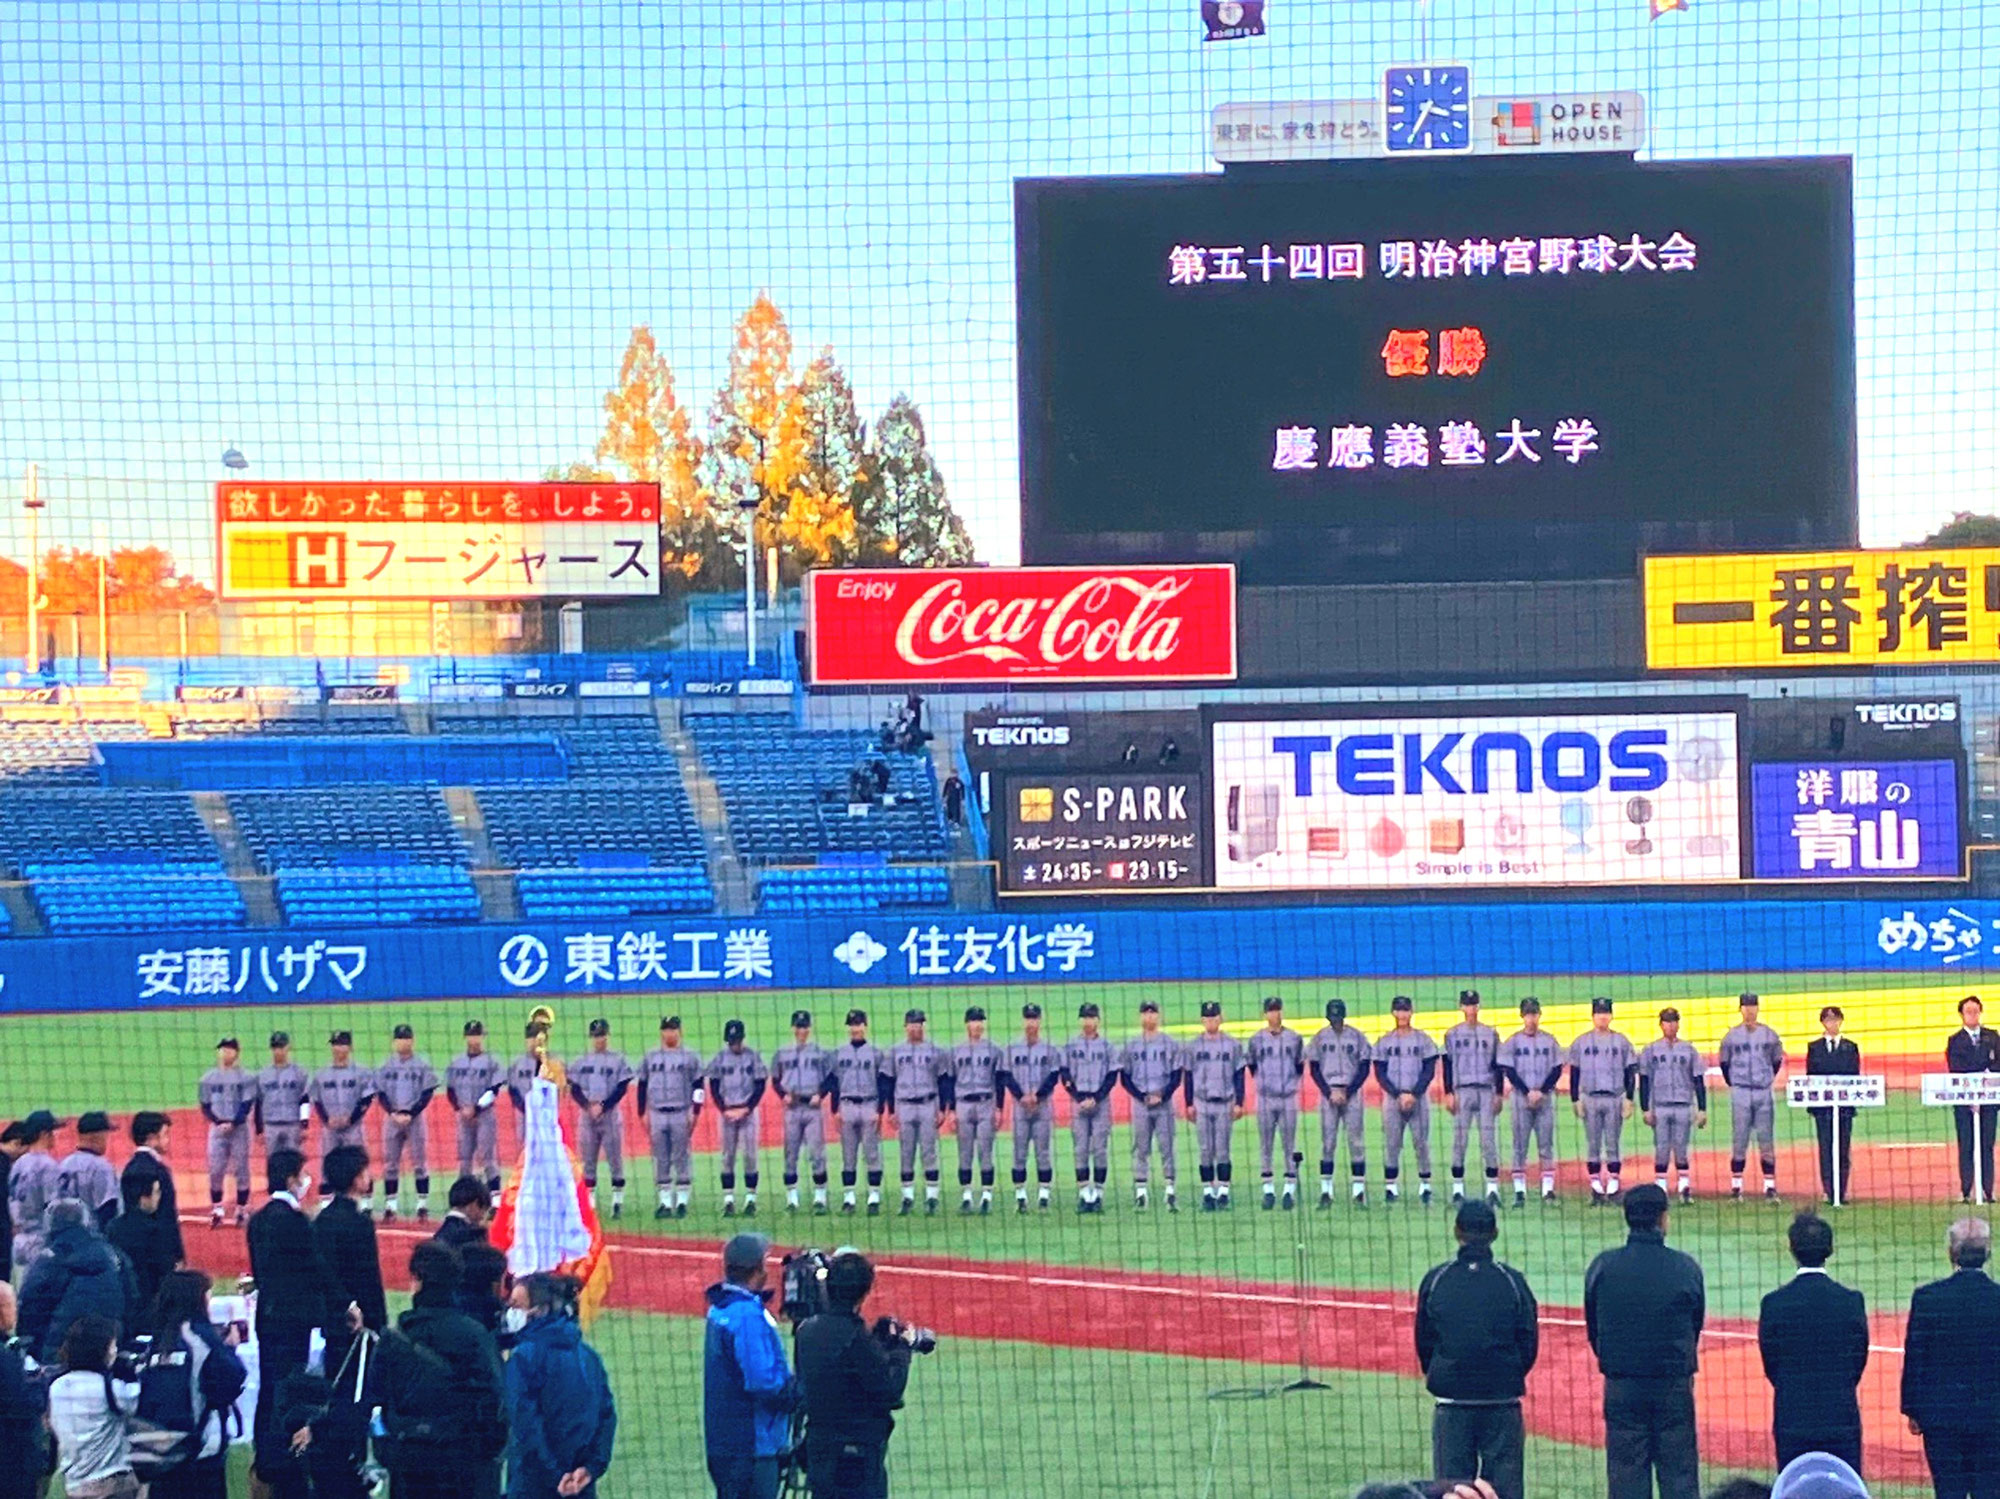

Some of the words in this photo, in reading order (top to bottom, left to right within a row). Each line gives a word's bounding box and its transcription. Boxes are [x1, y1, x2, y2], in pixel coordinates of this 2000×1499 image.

[1552, 102, 1622, 120] OPEN
[1552, 125, 1622, 142] HOUSE
[1168, 243, 1365, 286] 第五十四回
[1379, 231, 1697, 279] 明治神宮野球大会
[1381, 327, 1487, 376] 優勝
[1272, 417, 1599, 471] 慶應義塾大学
[229, 491, 653, 519] 欲しかった暮らしを、しよう。
[296, 536, 340, 584] H
[356, 533, 650, 584] フージャース
[837, 578, 898, 602] Enjoy
[1673, 562, 2000, 654] 一番搾
[1855, 702, 1957, 723] TEKNOS
[972, 727, 1070, 745] TEKNOS
[1273, 729, 1668, 796] TEKNOS
[1063, 786, 1188, 822] S-PARK
[1796, 769, 1911, 805] 洋服の
[1791, 809, 1920, 870] 青山
[1416, 861, 1472, 875] Simple
[1479, 861, 1493, 874] is
[1499, 860, 1539, 874] Best
[899, 923, 1096, 976] 住友化学
[1878, 911, 2000, 954] めちゃ
[136, 939, 367, 998] 安藤ハザマ
[563, 928, 774, 985] 東鉄工業
